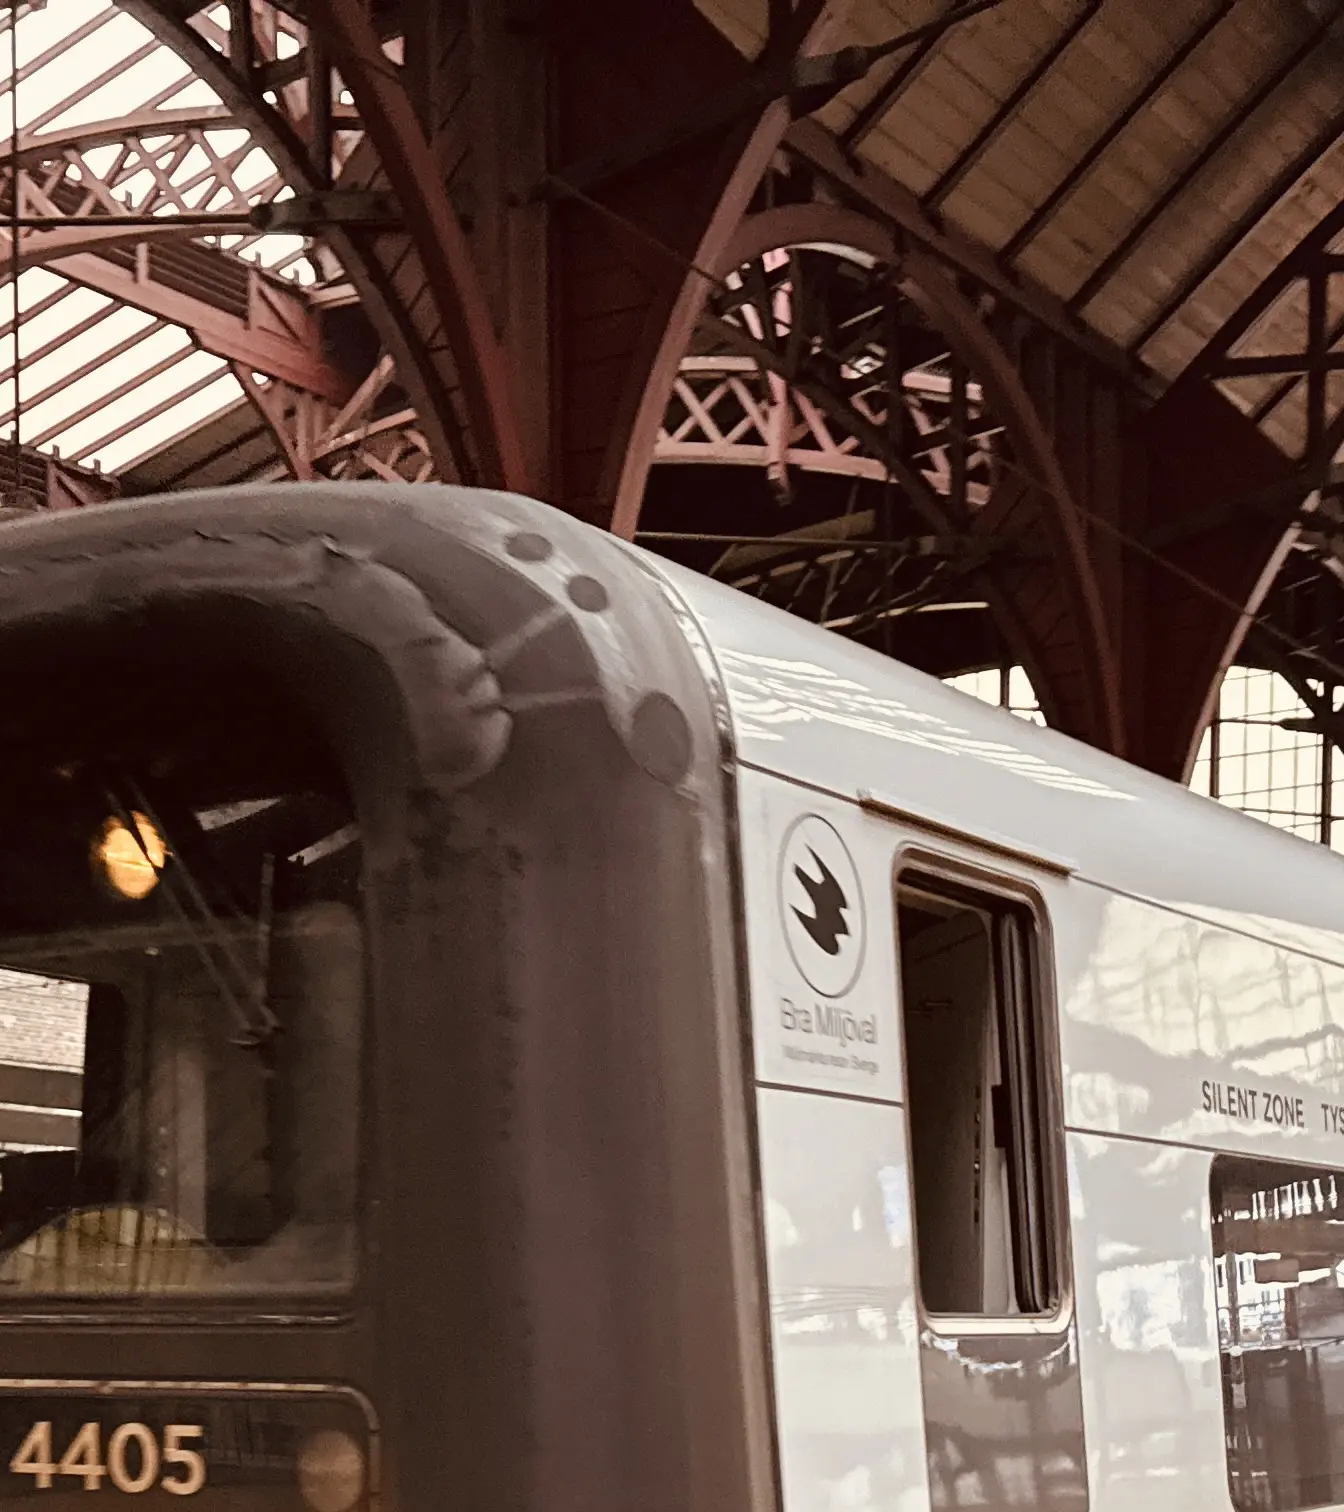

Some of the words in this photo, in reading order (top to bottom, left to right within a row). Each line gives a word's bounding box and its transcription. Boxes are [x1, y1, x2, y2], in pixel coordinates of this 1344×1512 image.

[1202, 1080, 1258, 1120] SILENT
[1262, 1092, 1305, 1128] ZONE
[9, 1420, 206, 1495] 4405
